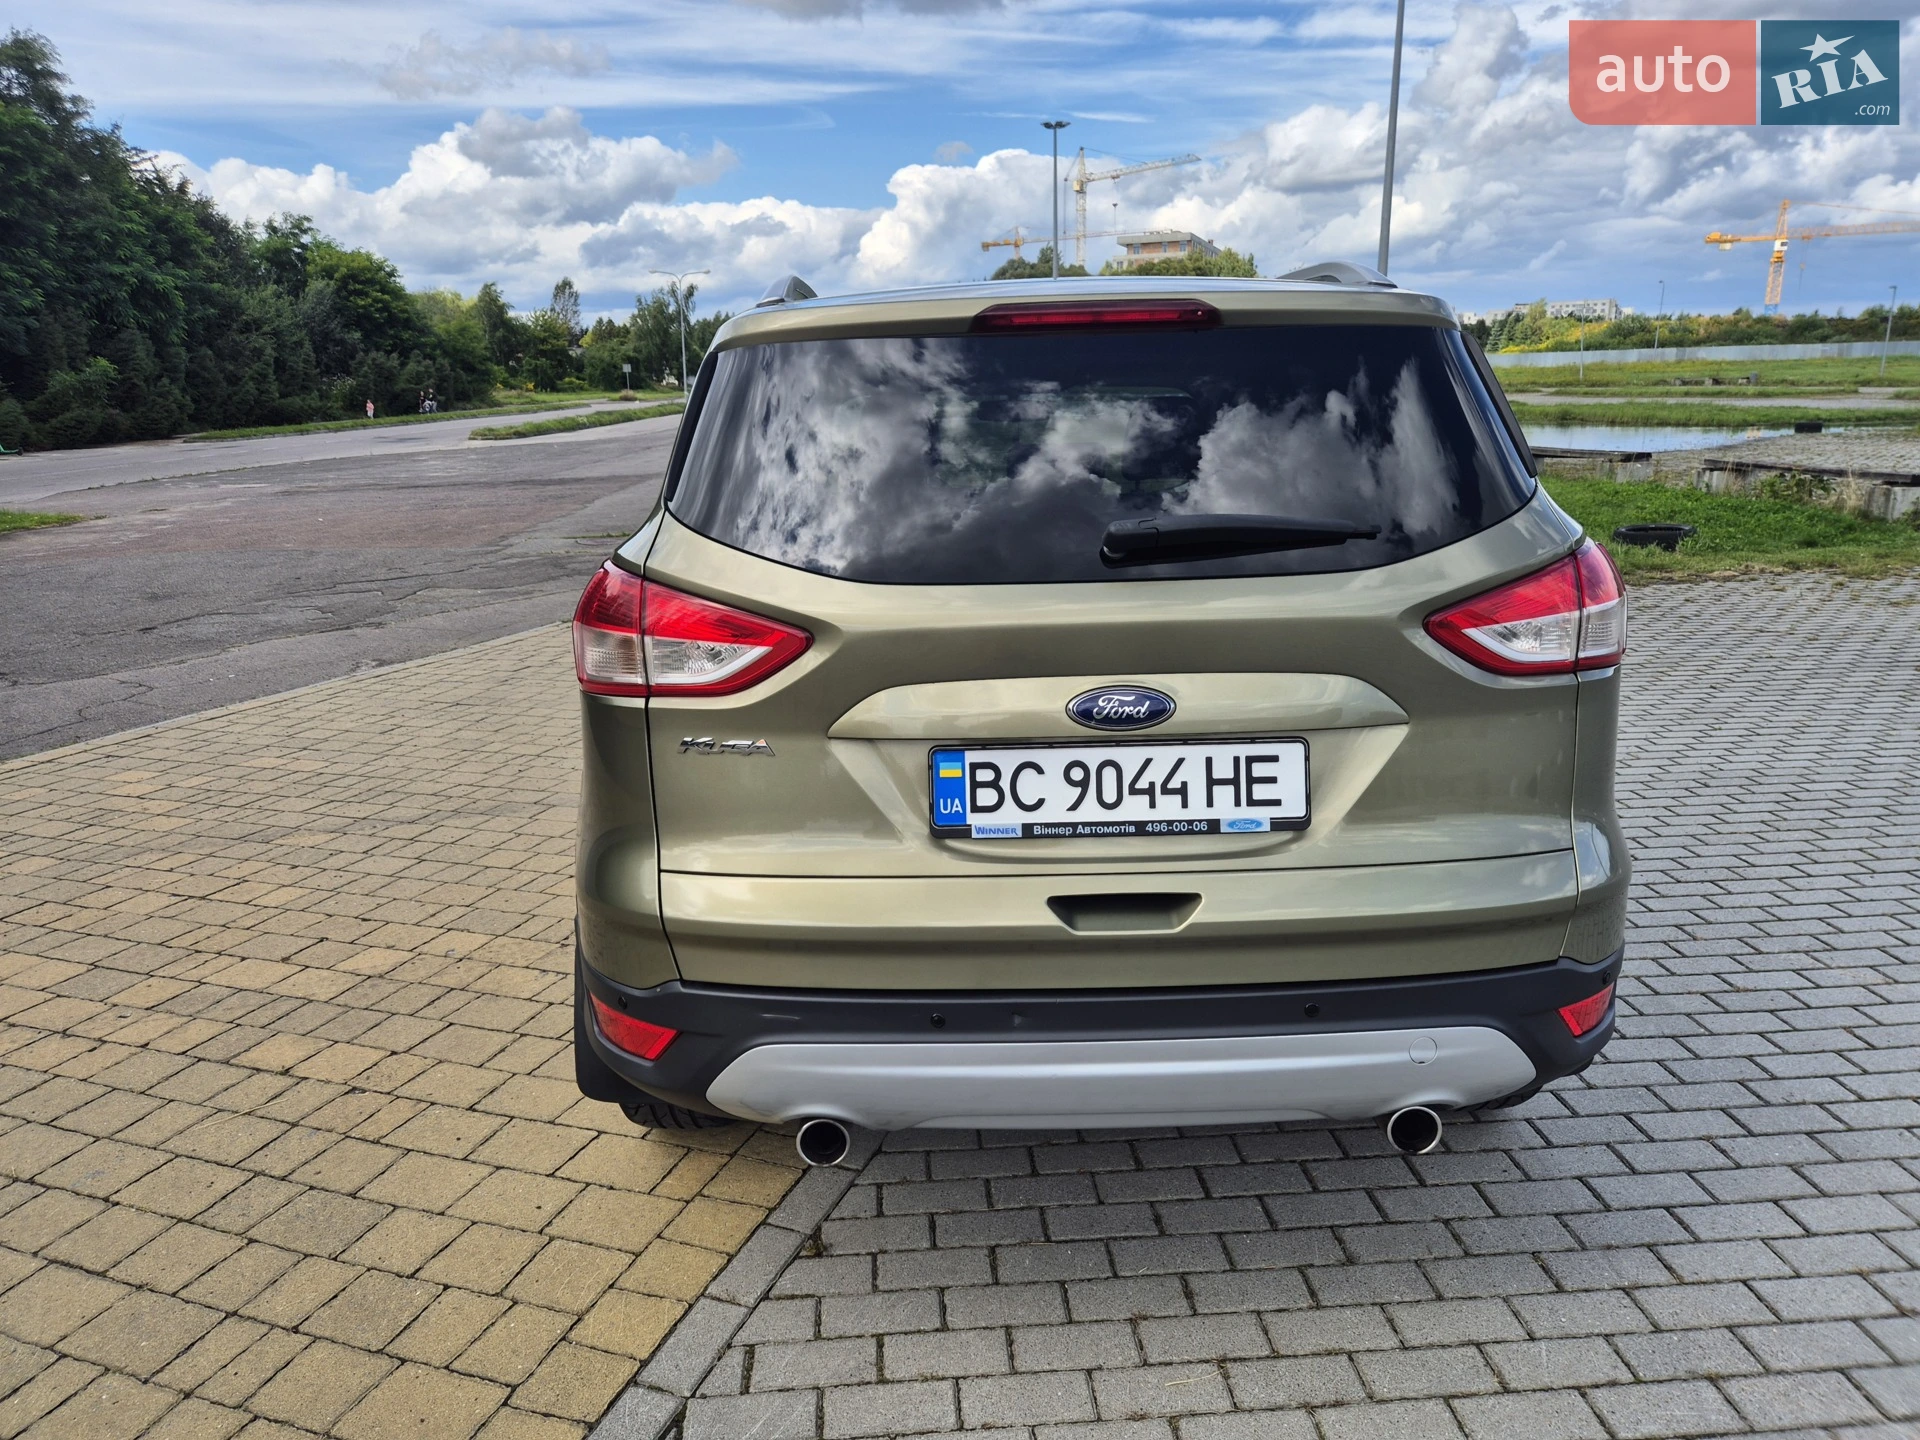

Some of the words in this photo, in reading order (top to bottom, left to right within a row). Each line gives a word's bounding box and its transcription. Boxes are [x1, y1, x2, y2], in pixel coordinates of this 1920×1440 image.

[1092, 695, 1149, 720] Ford
[969, 761, 1045, 814] BC
[1063, 757, 1189, 812] 9044
[1205, 755, 1282, 808] HE
[940, 798, 963, 814] UA
[1033, 824, 1073, 837] Віннер
[1076, 823, 1136, 835] Автомотів
[1145, 821, 1208, 833] 496-00-06
